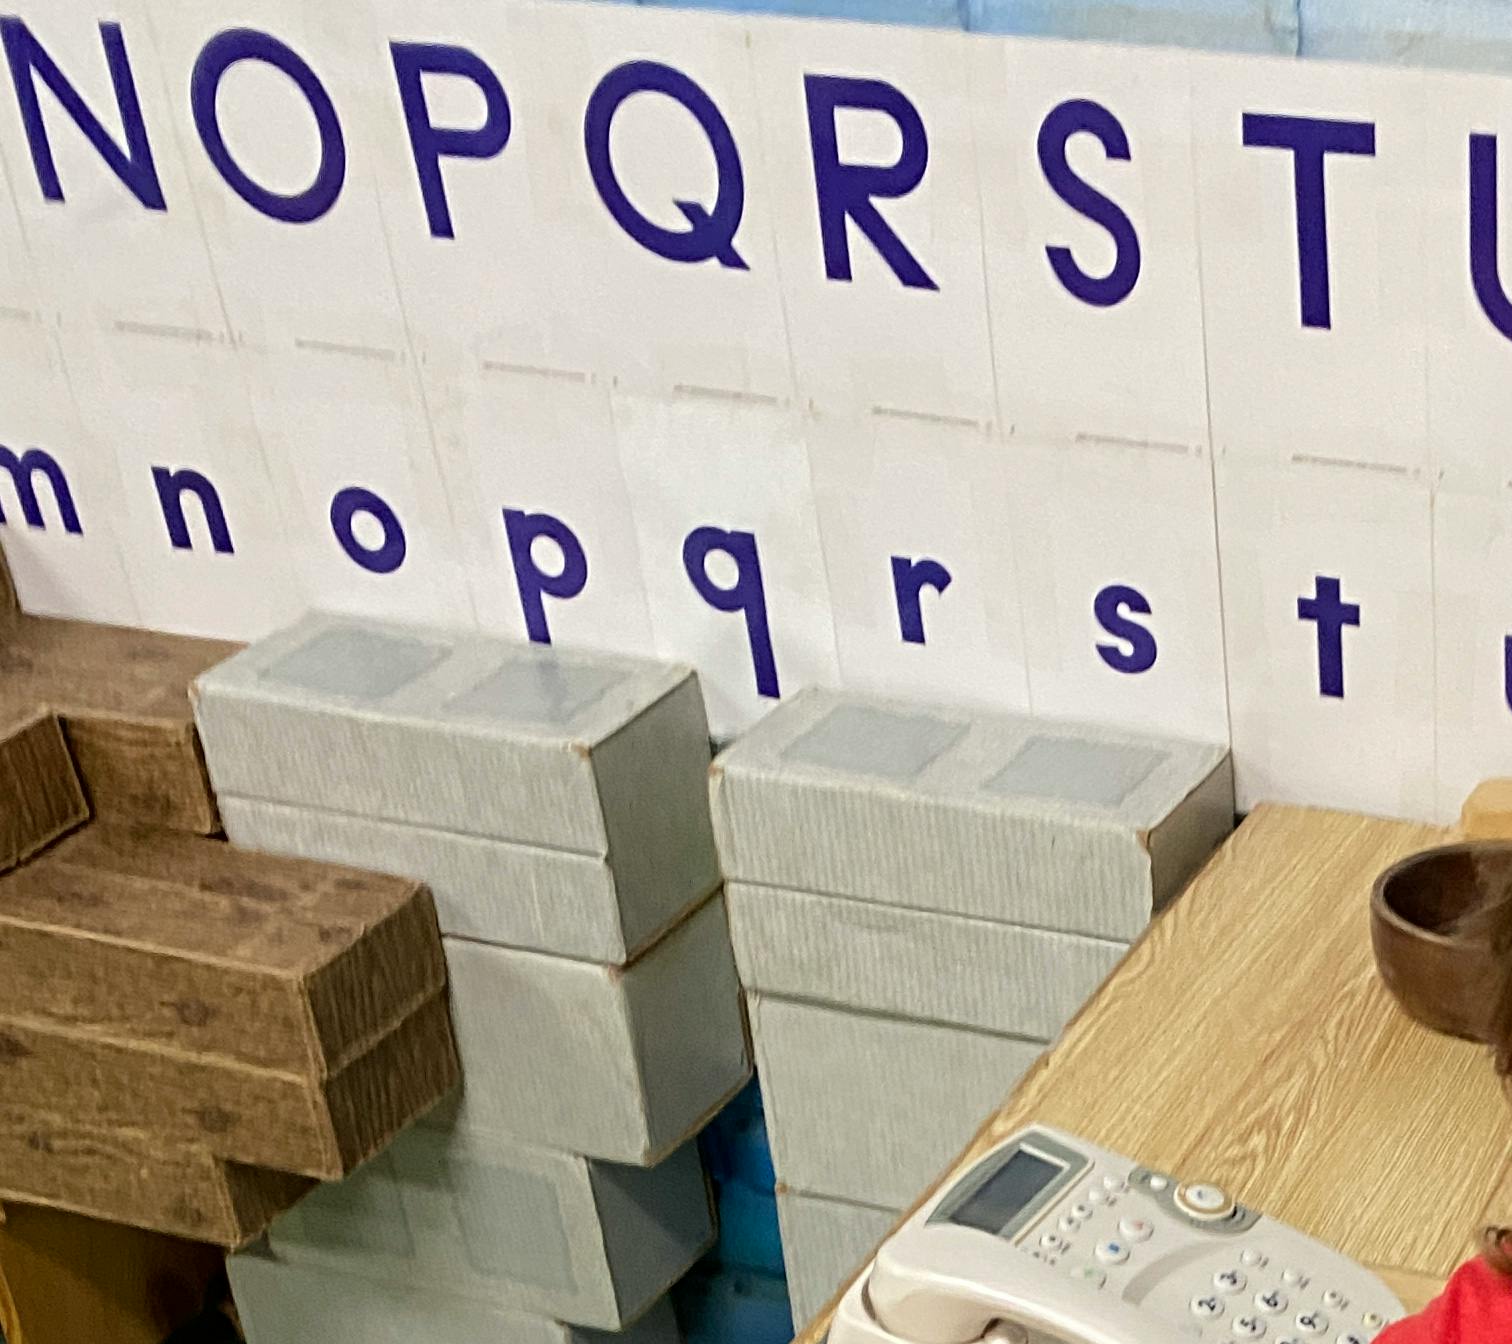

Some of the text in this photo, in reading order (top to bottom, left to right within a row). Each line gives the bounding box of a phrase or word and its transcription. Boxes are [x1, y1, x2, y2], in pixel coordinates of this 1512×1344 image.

[0, 18, 167, 211] N
[191, 28, 345, 224] O
[389, 42, 511, 239] P
[585, 60, 749, 271] Q
[804, 74, 939, 290] R
[1037, 99, 1141, 307] S
[1242, 113, 1375, 330] T
[151, 466, 234, 554] n
[330, 487, 406, 574] o
[502, 508, 588, 645] p
[683, 525, 780, 700] q
[890, 555, 952, 645] r
[1093, 585, 1157, 674] s
[1297, 576, 1360, 699] t
